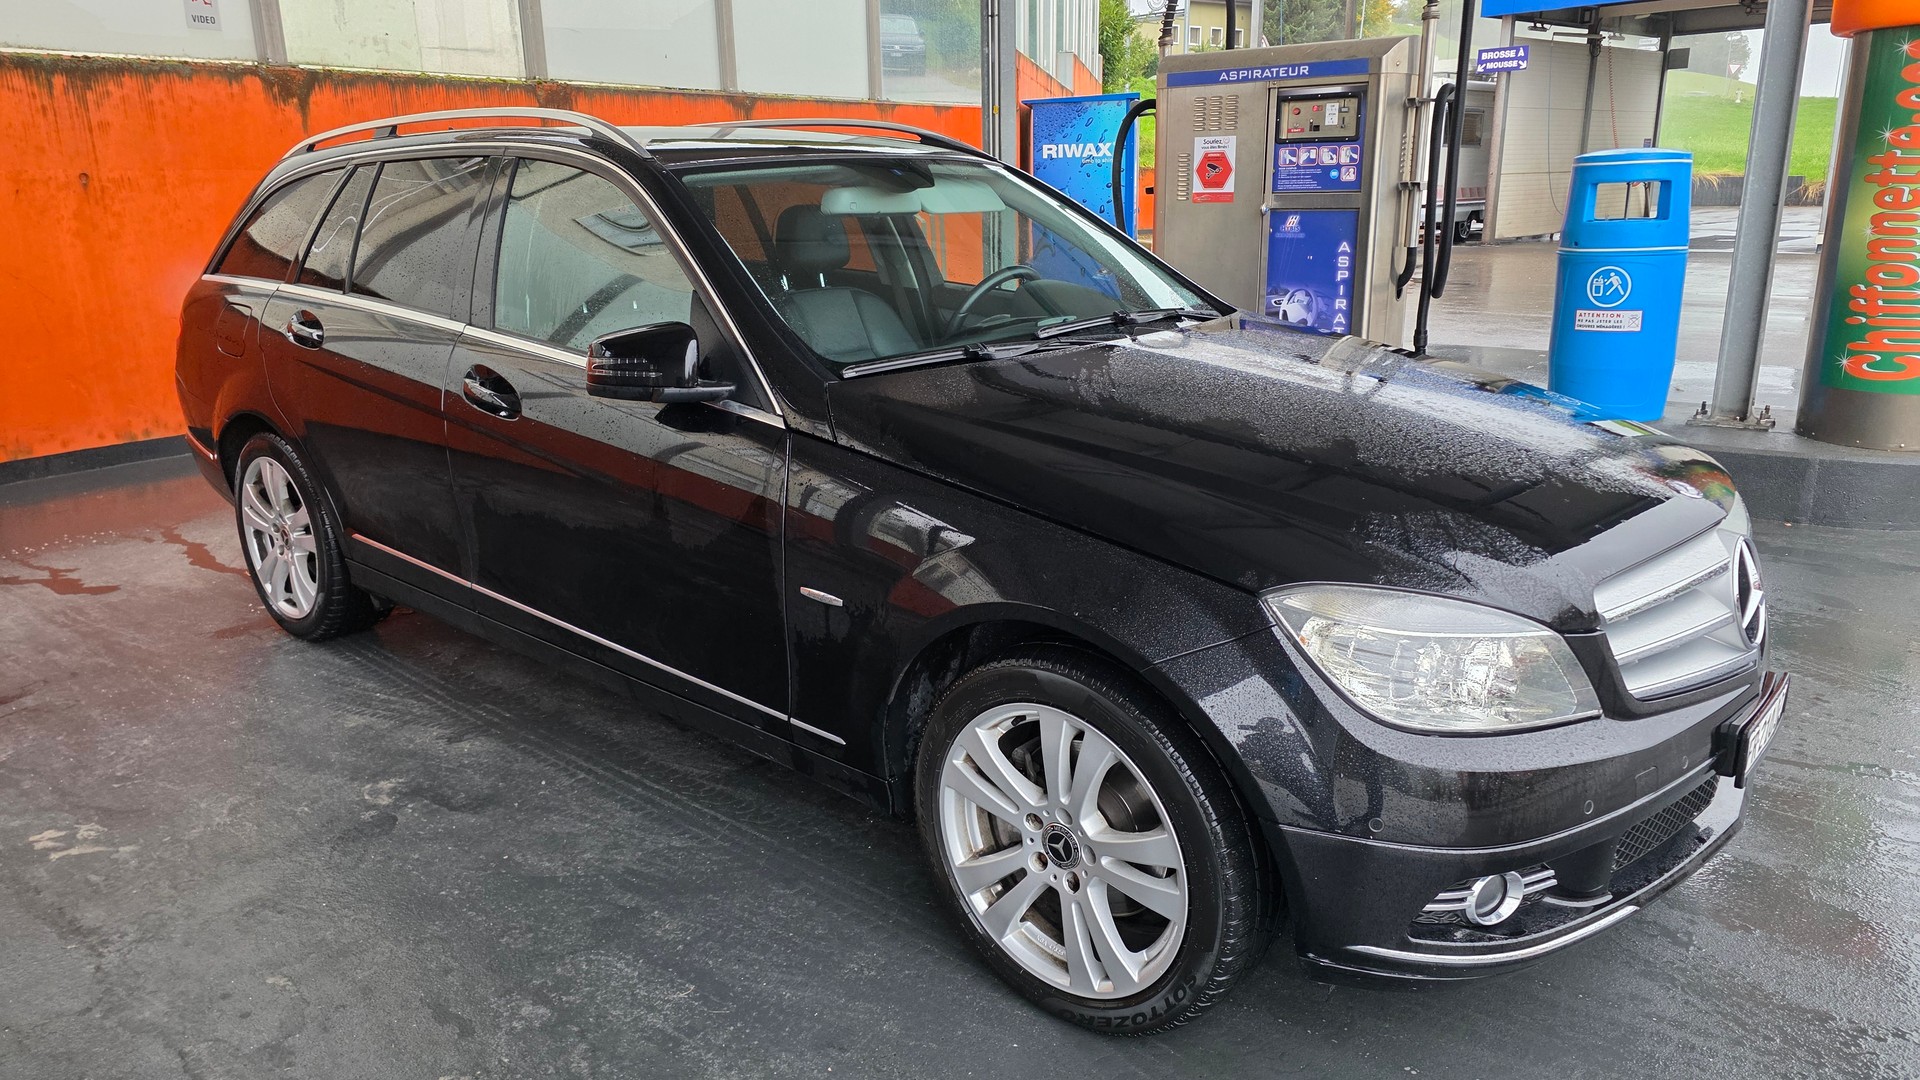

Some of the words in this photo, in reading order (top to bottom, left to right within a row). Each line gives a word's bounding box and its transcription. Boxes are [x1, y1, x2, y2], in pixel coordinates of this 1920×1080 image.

[191, 14, 216, 25] VIDEO
[1481, 49, 1516, 60] BROSSE
[1517, 47, 1525, 57] À
[1486, 60, 1518, 69] MOUSSE
[1219, 65, 1309, 82] ASPIRATEUR
[1042, 142, 1113, 159] RIWAX
[1844, 38, 1920, 382] Chiffonnette.
[1058, 974, 1198, 1029] SOTTOZERO
